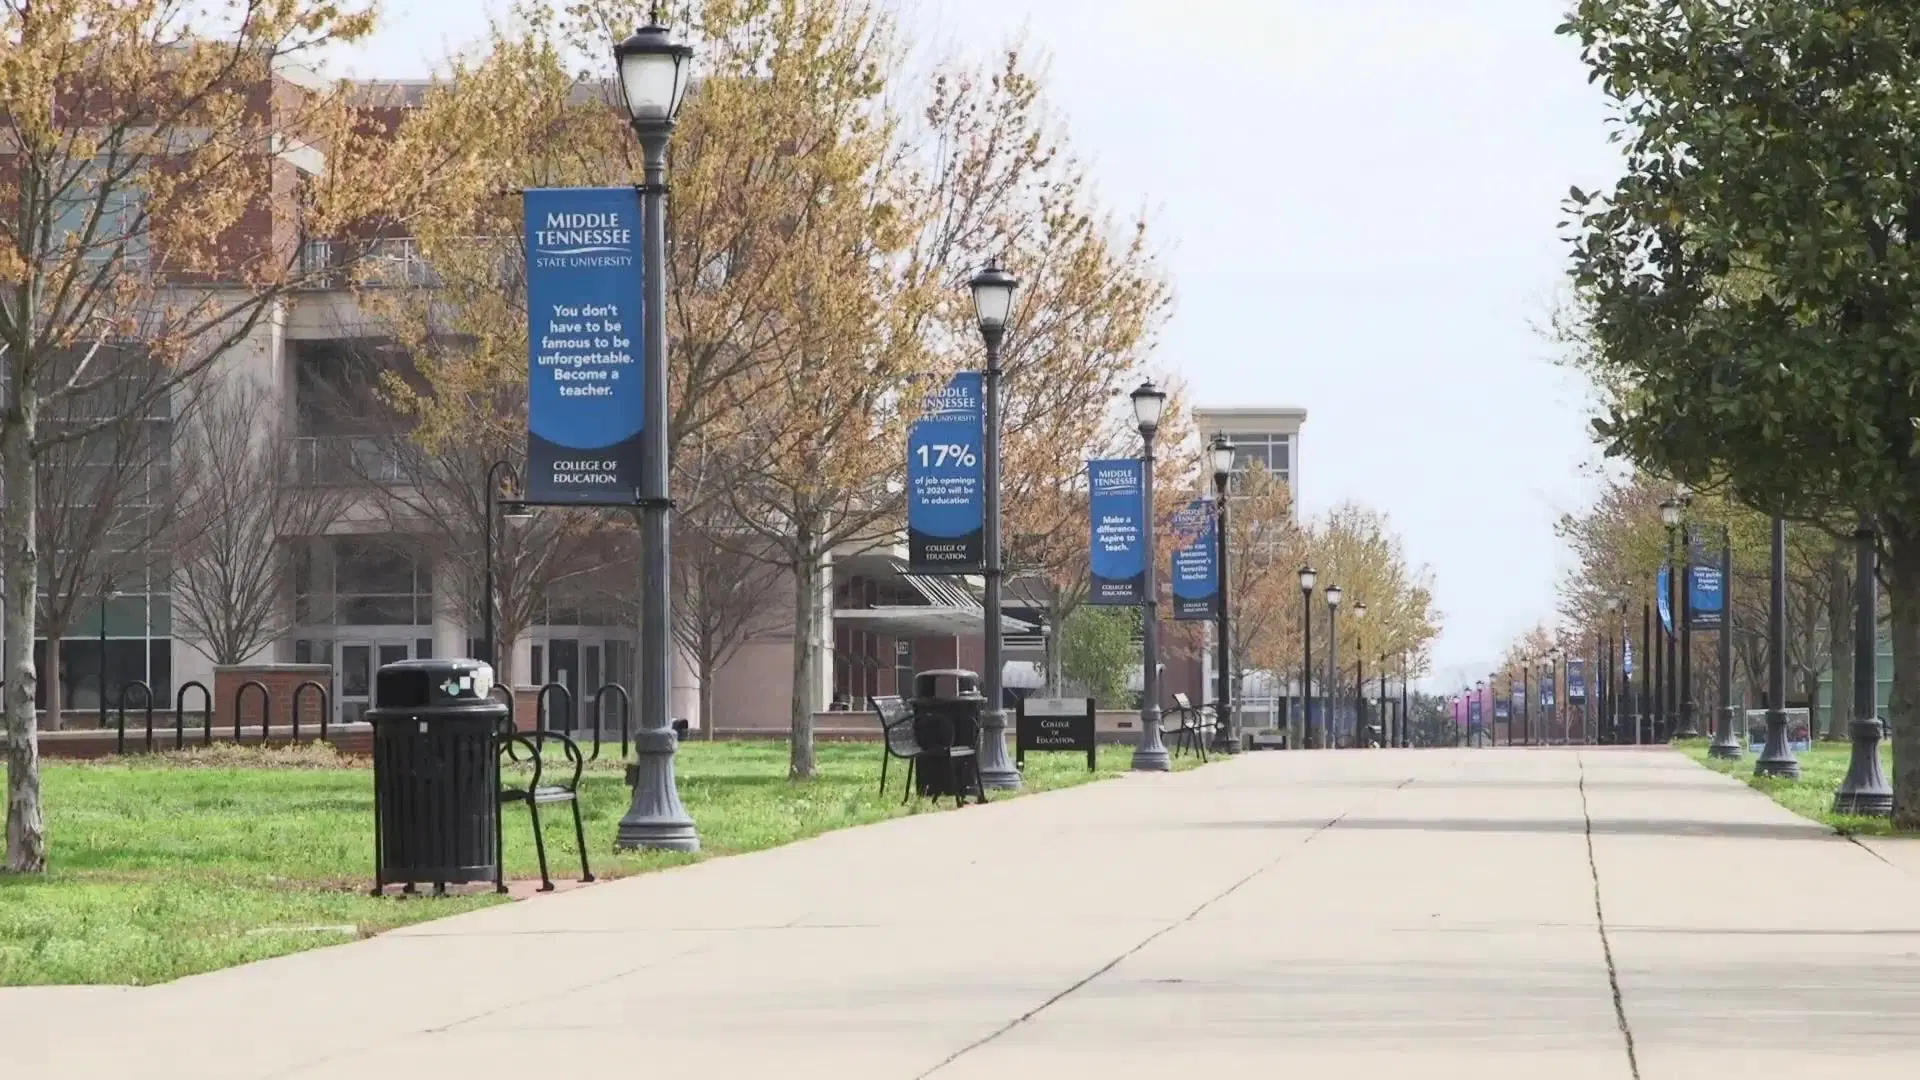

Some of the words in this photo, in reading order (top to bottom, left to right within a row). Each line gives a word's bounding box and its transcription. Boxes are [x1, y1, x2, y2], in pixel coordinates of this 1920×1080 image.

[547, 212, 619, 228] MIDDLE
[535, 229, 631, 245] TENNESSEE
[536, 257, 566, 267] STATE
[570, 256, 632, 267] UNIVERSITY
[553, 304, 578, 317] You
[582, 304, 618, 316] don't
[550, 320, 581, 333] have
[586, 321, 600, 332] to
[604, 320, 622, 332] be
[541, 336, 591, 348] famous
[594, 337, 609, 348] to
[613, 335, 630, 347] be
[538, 352, 634, 367] unforgettable.
[554, 369, 607, 380] Become
[611, 371, 619, 379] a
[560, 384, 613, 396] teacher.
[917, 444, 976, 467] 17%
[553, 461, 600, 470] COLLEGE
[602, 461, 618, 470] OF
[553, 474, 617, 483] EDUCATION
[1099, 470, 1132, 478] MIDDLE
[915, 476, 923, 484] of
[925, 477, 938, 486] job
[940, 476, 976, 486] openings
[1094, 477, 1137, 486] TENNESSEE
[948, 486, 962, 494] will
[964, 486, 974, 494] be
[1103, 516, 1124, 524] Make
[1099, 534, 1124, 543] Aspire
[1036, 736, 1075, 744] EDUCATION
